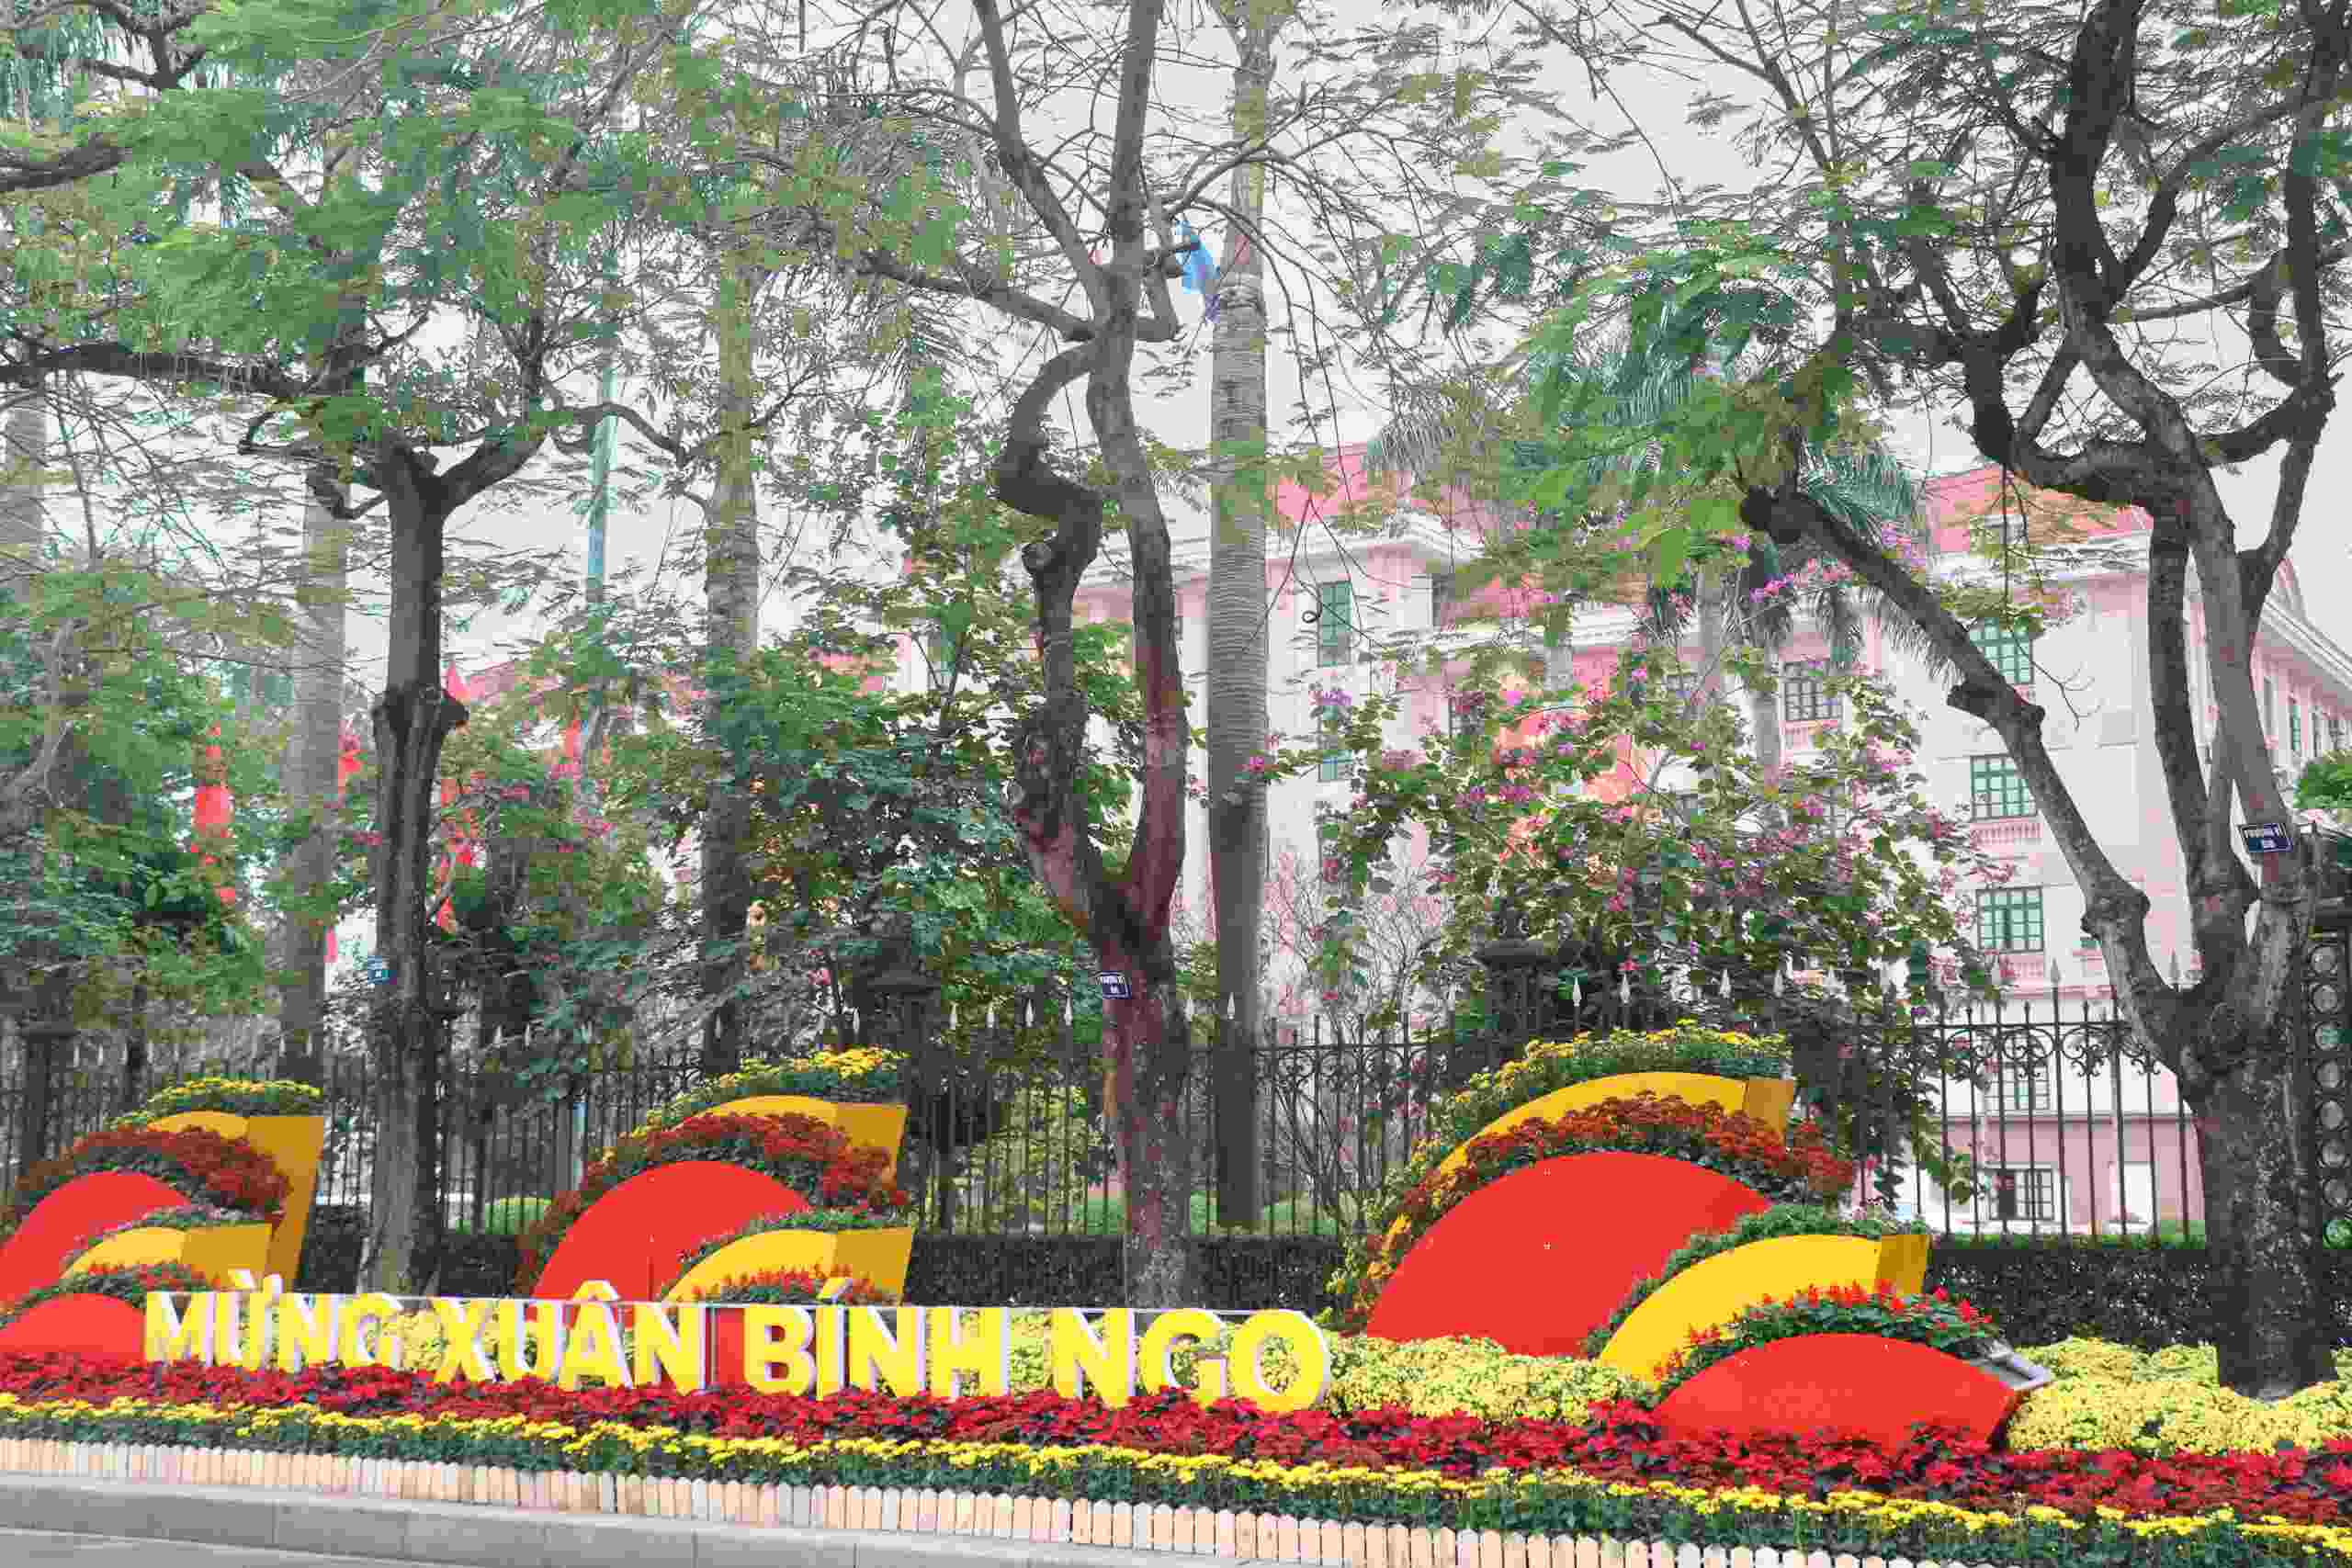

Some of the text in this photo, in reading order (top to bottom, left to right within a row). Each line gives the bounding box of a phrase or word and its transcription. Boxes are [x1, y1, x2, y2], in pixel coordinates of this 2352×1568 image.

[146, 1269, 402, 1371] MỪNG
[432, 1280, 707, 1393] XUÂN
[741, 1278, 1009, 1399] BÍNH
